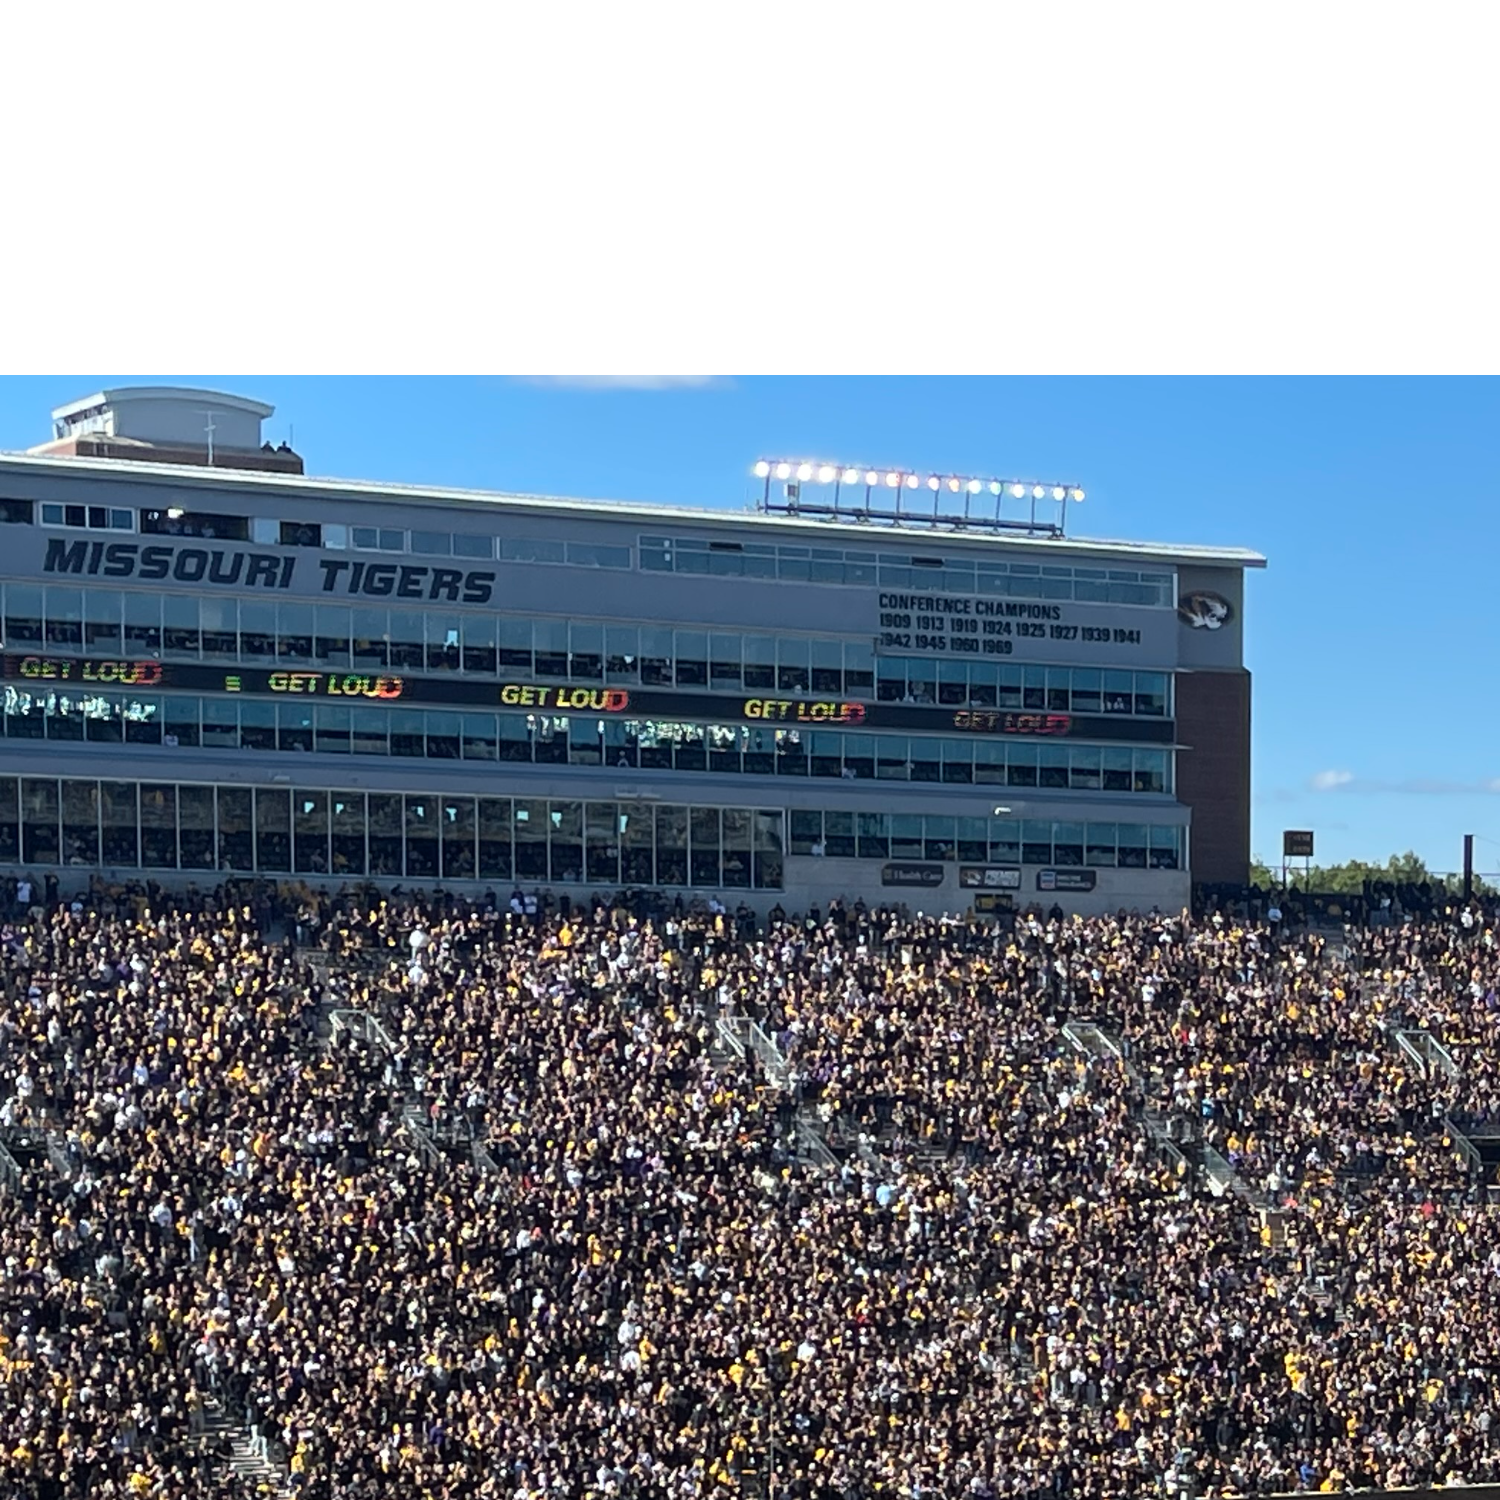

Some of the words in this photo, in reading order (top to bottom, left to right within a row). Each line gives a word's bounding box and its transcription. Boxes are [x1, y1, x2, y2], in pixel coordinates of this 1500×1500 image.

[43, 538, 296, 588] MISSOURI
[319, 559, 496, 604] TIGERS
[879, 593, 971, 615] CONFERENCE
[975, 600, 1061, 621] CHAMPIONS
[880, 613, 911, 629] 1909
[916, 615, 944, 631] 1913
[951, 618, 978, 633] 1919
[983, 620, 1012, 636] 1924
[1016, 622, 1046, 638] 1925
[1050, 624, 1078, 640] 1927
[1082, 626, 1110, 642] 1939
[1113, 628, 1140, 645] 1941
[880, 632, 911, 648] 1942
[915, 634, 946, 650] 1945
[950, 636, 979, 652] 1960
[983, 638, 1013, 654] 1969
[20, 657, 76, 679] GET
[83, 660, 162, 685] LOUD
[269, 673, 323, 692] GET
[328, 674, 402, 699] LOUD
[501, 685, 550, 706] GET
[556, 688, 629, 711] LOUD
[744, 699, 792, 720] GET
[798, 702, 865, 725] LOUD
